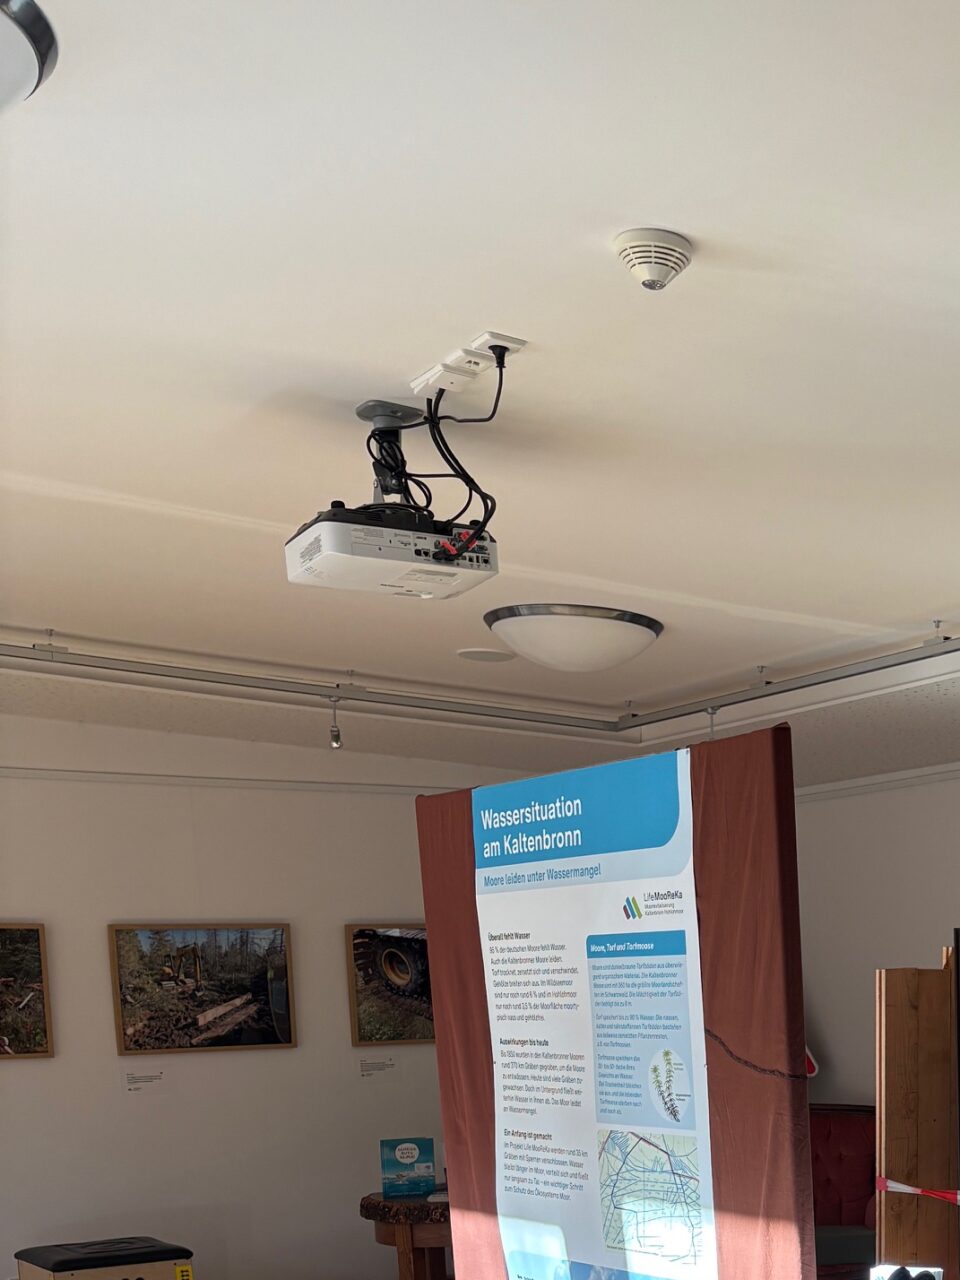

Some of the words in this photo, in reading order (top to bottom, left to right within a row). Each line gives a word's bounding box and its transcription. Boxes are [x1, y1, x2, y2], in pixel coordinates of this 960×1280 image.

[481, 796, 582, 830] Wassersituation
[484, 841, 501, 858] am
[504, 829, 581, 855] Kaltenbronn
[484, 876, 504, 887] Moore
[505, 872, 526, 885] leiden
[527, 871, 545, 883] unter
[547, 863, 601, 880] Wassermangel
